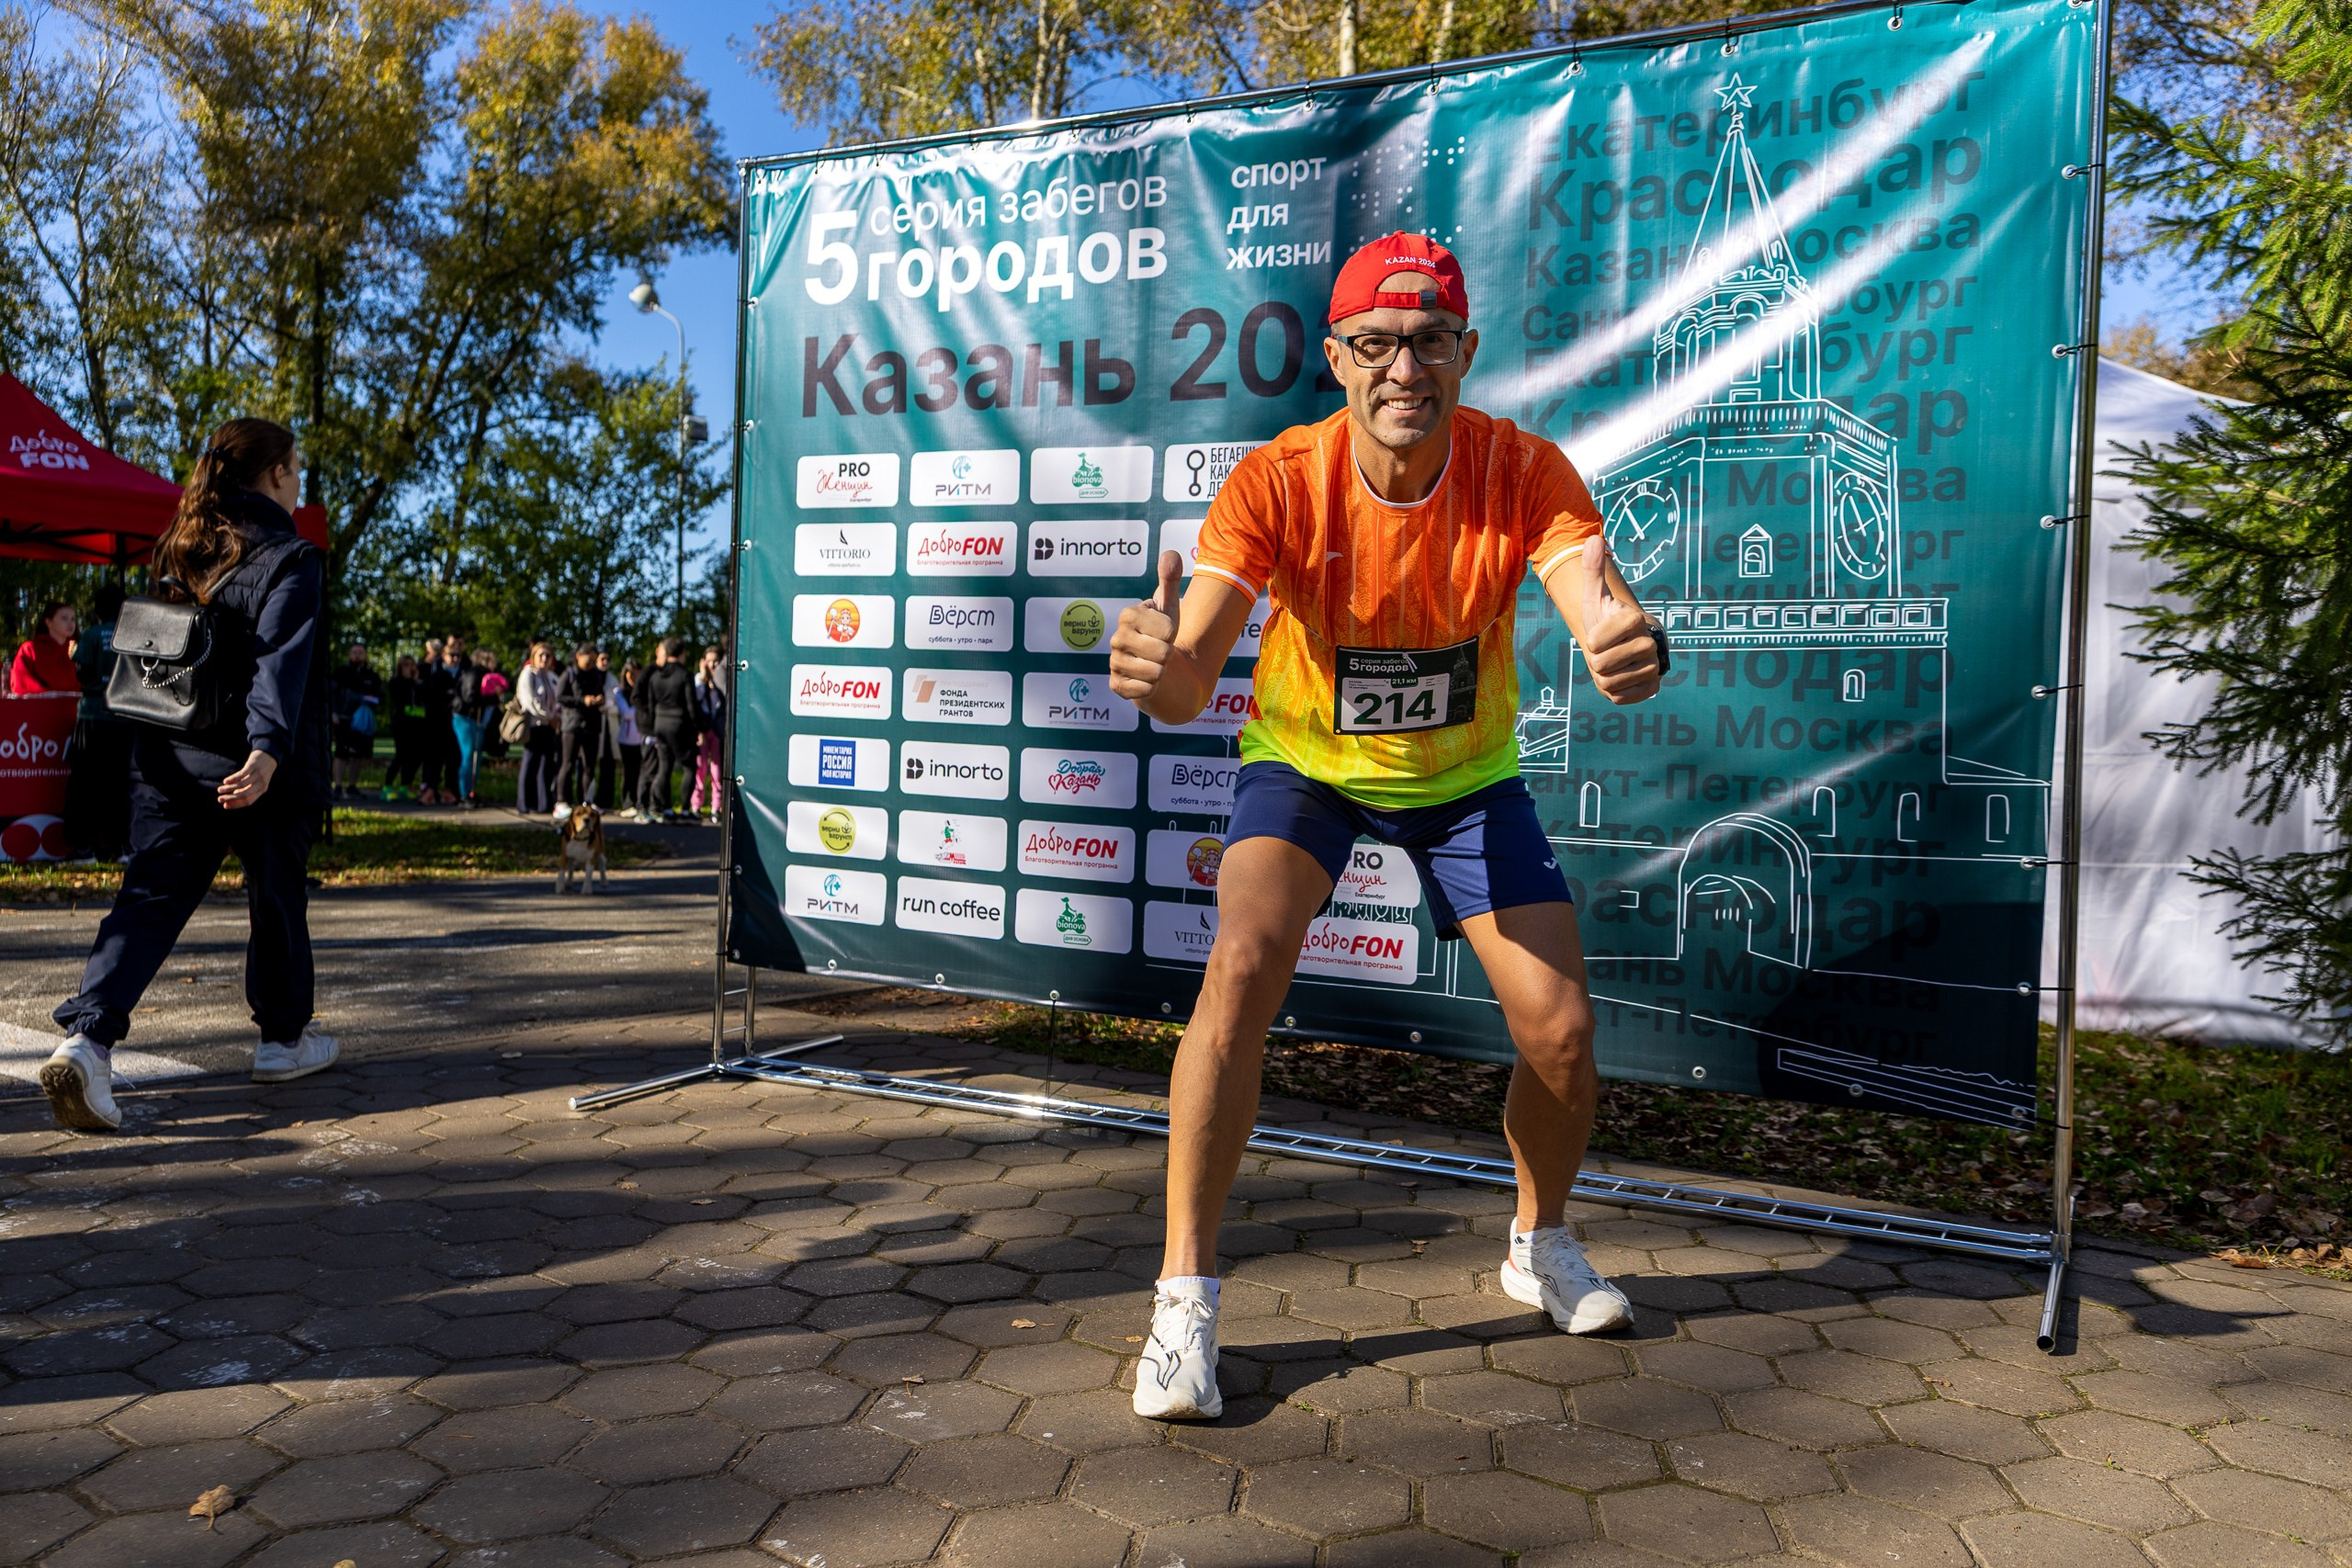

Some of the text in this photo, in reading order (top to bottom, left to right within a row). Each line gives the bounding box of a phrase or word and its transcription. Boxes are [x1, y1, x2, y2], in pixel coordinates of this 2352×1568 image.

[1231, 156, 1328, 197] спорт
[870, 175, 1168, 245] серия забегов
[1227, 203, 1289, 235] для
[804, 210, 1168, 312] 5 городов
[1226, 240, 1332, 271] жизни
[1385, 256, 1437, 269] KAZAN 2024
[802, 300, 1347, 418] Казань 20
[9, 428, 79, 454] Добро
[20, 451, 90, 470] FON
[839, 462, 870, 477] PRO
[1072, 476, 1102, 484] bionova
[1210, 464, 1231, 479] КАК
[817, 468, 874, 498] Женщин
[935, 483, 991, 496] РИТМ
[918, 528, 1004, 557] ДоброFON
[1060, 537, 1142, 556] innorto
[820, 548, 871, 558] VITTORIO
[1064, 620, 1086, 628] верни
[929, 636, 953, 644] суббота
[957, 637, 973, 645] утро
[1349, 658, 1409, 673] 5 городов
[800, 671, 881, 699] ДоброFON
[940, 689, 967, 697] ФОНДА
[939, 709, 974, 717] ГРАНТОВ
[940, 699, 1005, 709] ПРЕЗИДЕНТСКИХ
[1049, 705, 1110, 720] РИТМ
[1353, 690, 1436, 725] 214
[1715, 705, 1955, 755] Москва
[822, 754, 853, 770] РОССИЯ
[930, 759, 1003, 781] innorto
[1057, 759, 1105, 776] Добрая
[832, 771, 852, 779] ИСТОРИЯ
[1048, 773, 1101, 795] Казань
[1170, 797, 1199, 806] суббота
[1532, 763, 1951, 823] анкт-Петербург
[1025, 826, 1119, 860] ДоброFON
[1024, 856, 1118, 870] Благотворительная программа
[1350, 851, 1384, 870] RO
[1339, 872, 1387, 893] нщин
[808, 897, 859, 915] РИТМ
[903, 897, 1001, 921] run coffee
[1057, 921, 1086, 931] bionova
[1174, 931, 1216, 946] VITTO
[1363, 961, 1404, 971] программа
